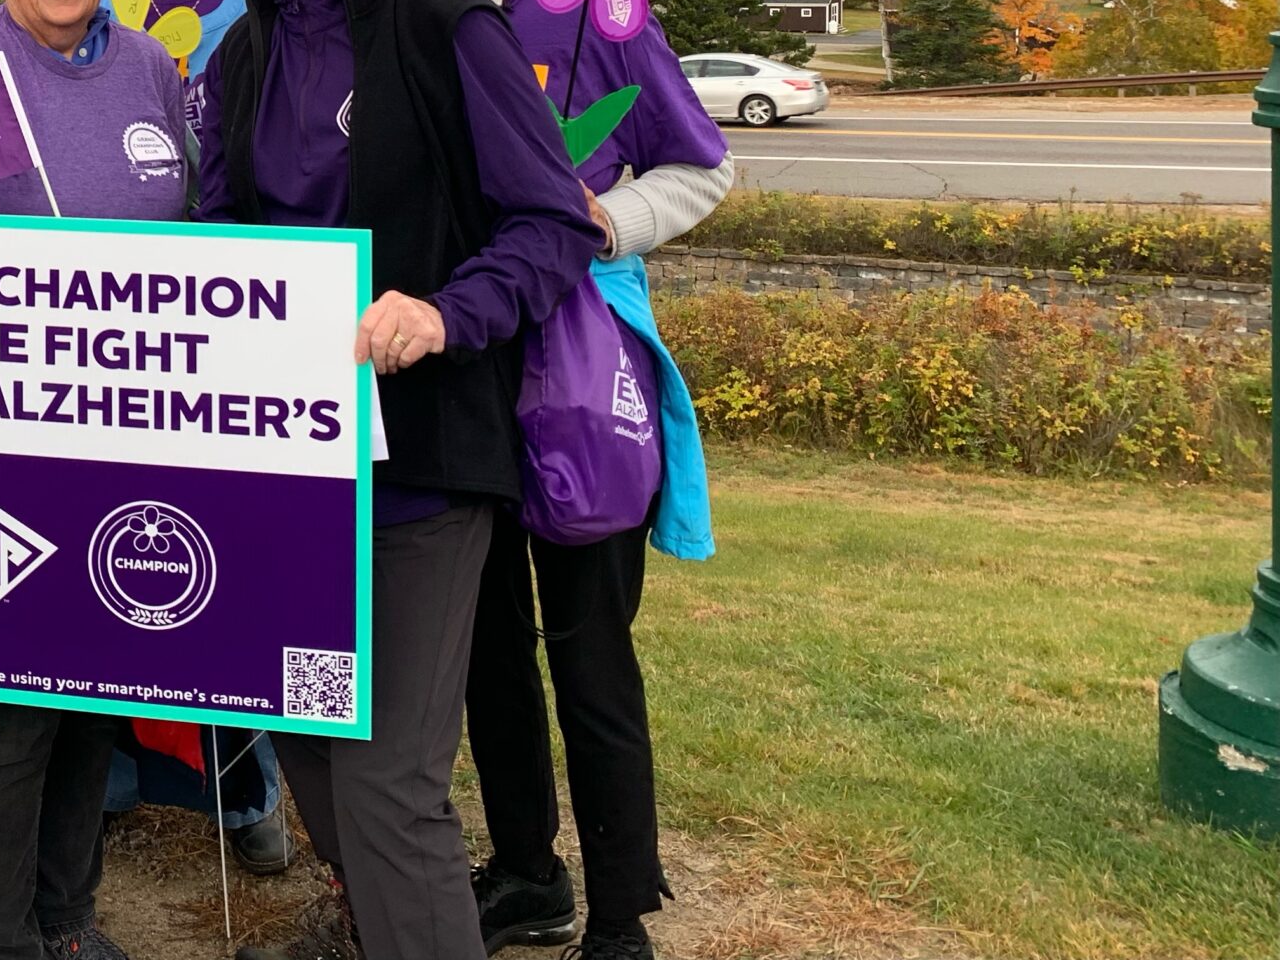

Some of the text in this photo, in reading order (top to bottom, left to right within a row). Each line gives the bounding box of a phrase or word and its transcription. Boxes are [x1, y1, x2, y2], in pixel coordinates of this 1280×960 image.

[45, 325, 209, 374] FIGHT
[114, 557, 189, 574] CHAMPION
[10, 671, 52, 690] using
[56, 678, 93, 692] your
[97, 680, 207, 702] smartphone's
[210, 693, 274, 709] camera.
